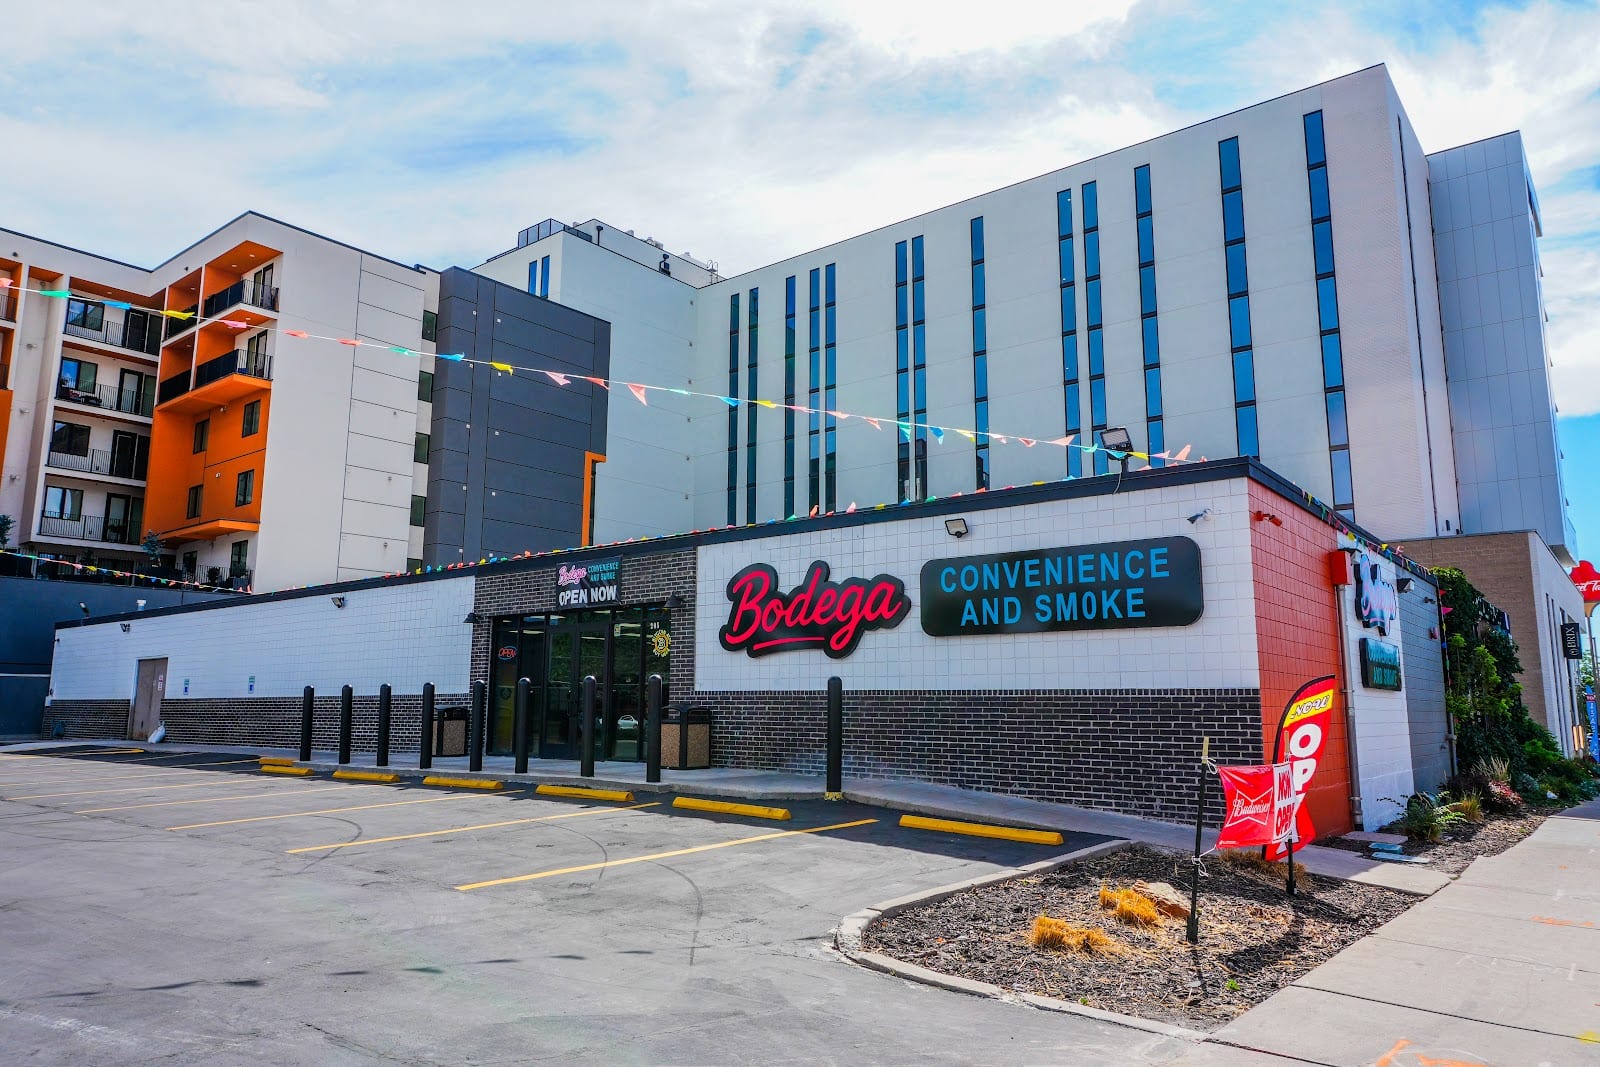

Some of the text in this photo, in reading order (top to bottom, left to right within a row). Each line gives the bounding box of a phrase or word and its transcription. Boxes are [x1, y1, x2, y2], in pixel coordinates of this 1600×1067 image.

[558, 565, 587, 586] Bodega
[940, 547, 1170, 593] CONVENIENCE
[559, 585, 617, 606] OPEN NOW
[725, 567, 902, 650] Bodega
[960, 588, 1146, 627] AND SMOKE
[1565, 627, 1577, 648] BRIX
[499, 648, 516, 657] OPEN
[1290, 695, 1330, 719] NOW
[1233, 799, 1270, 817] Budweiser
